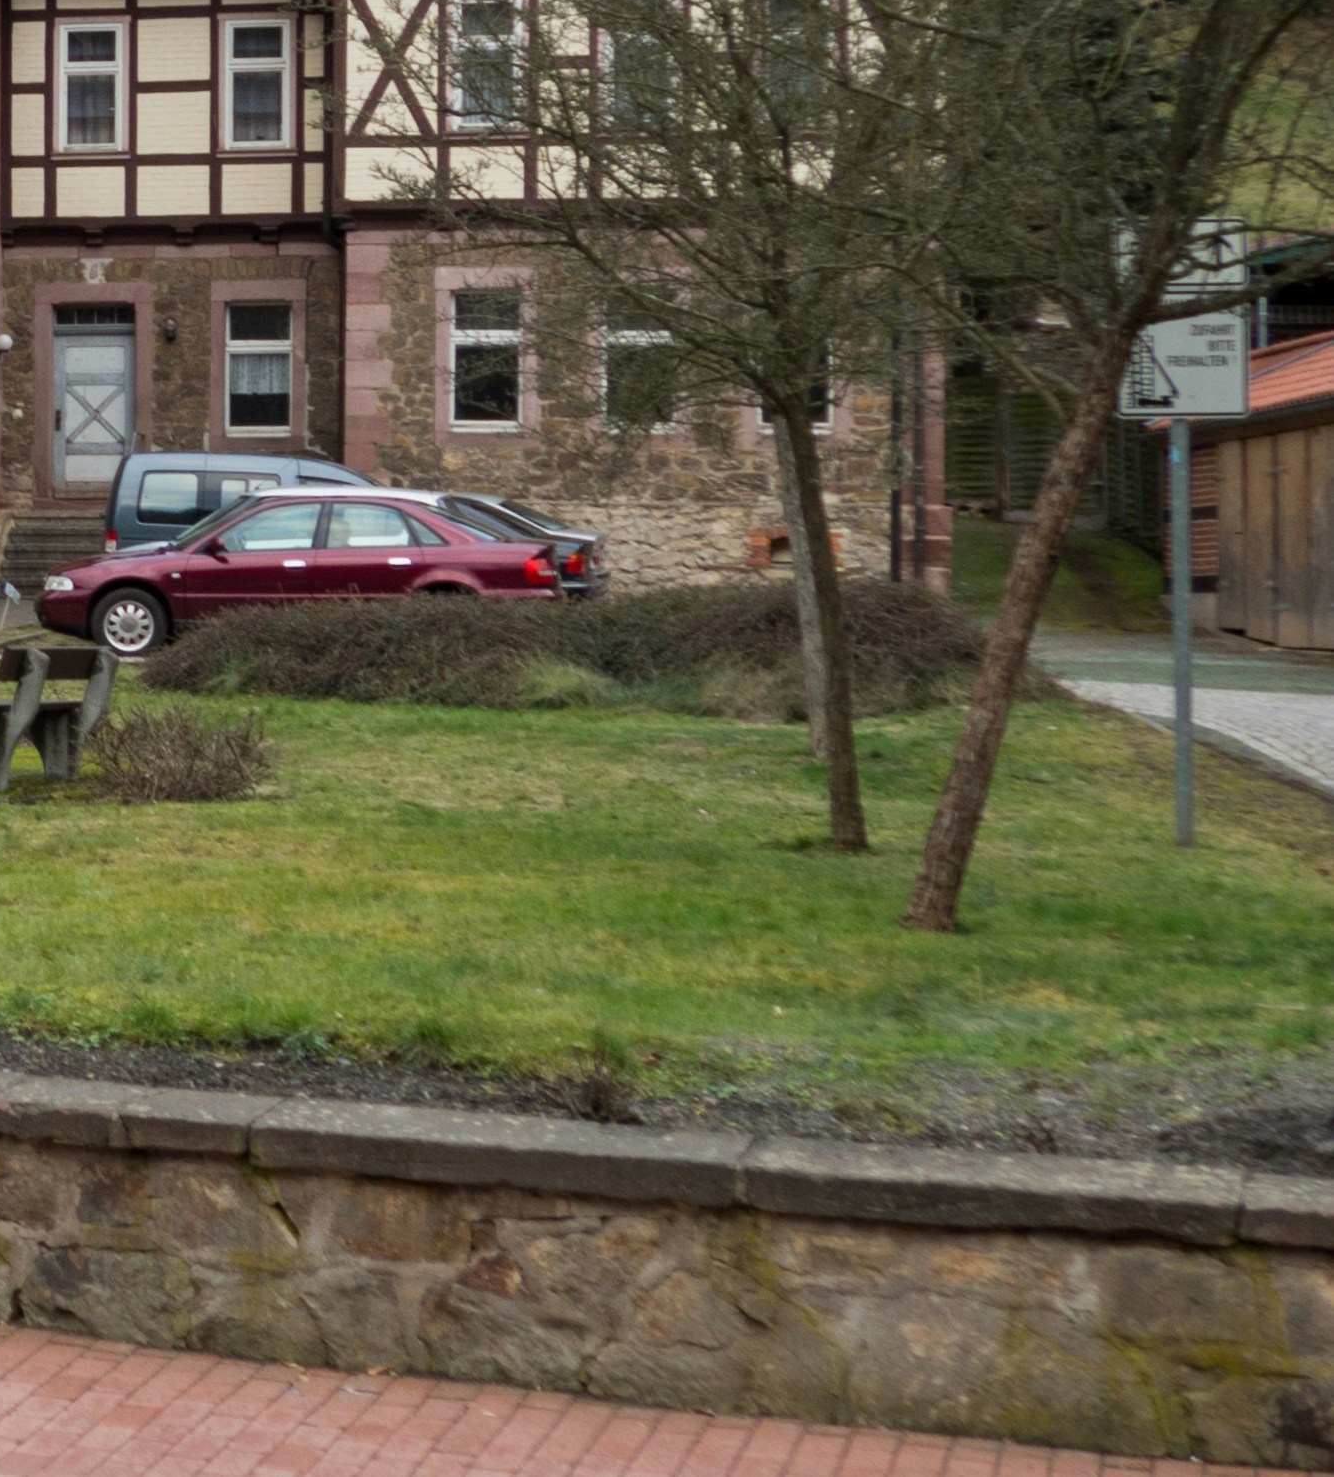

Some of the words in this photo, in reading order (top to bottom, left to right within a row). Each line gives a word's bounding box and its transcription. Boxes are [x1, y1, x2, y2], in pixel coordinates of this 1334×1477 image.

[1190, 324, 1236, 336] ZUFAHRT
[1208, 340, 1236, 351] BITTE
[1168, 355, 1229, 367] FREIHALTEN
